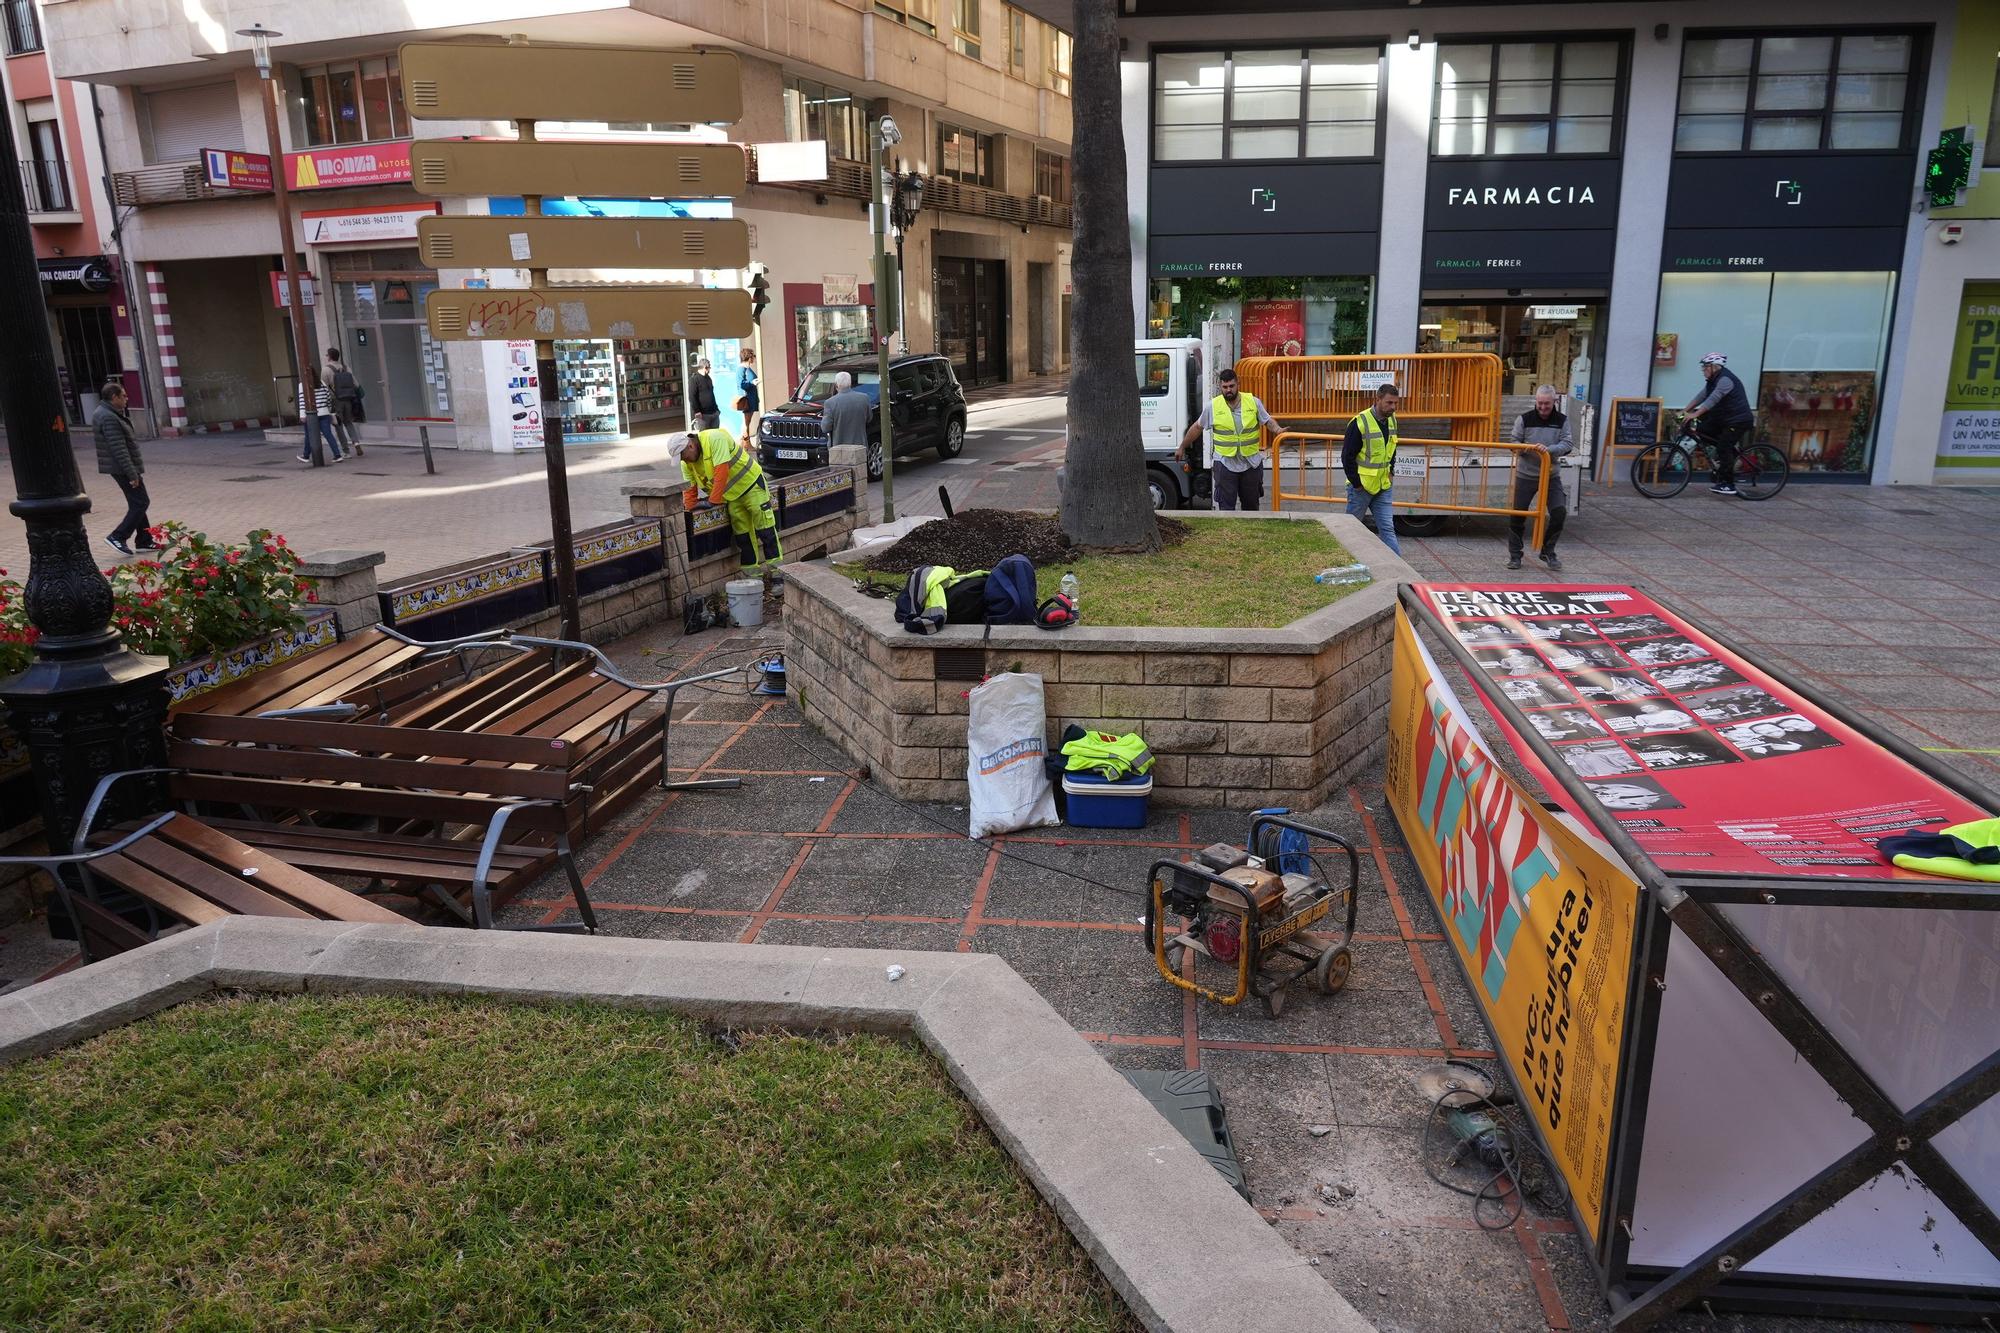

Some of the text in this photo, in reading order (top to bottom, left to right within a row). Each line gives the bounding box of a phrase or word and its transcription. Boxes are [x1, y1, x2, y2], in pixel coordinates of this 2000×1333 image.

[210, 153, 227, 180] L
[1448, 186, 1595, 205] FARMACIA
[1160, 262, 1243, 271] FARMACIA FERRER
[1435, 259, 1522, 268] FARMACIA FERRER
[1675, 257, 1764, 265] FARMACIA FERRER
[1968, 305, 1984, 316] En
[1957, 383, 1989, 397] Vine
[1955, 416, 1973, 427] ACÍ
[1974, 418, 1989, 428] NO
[1953, 430, 1967, 440] UN
[1395, 456, 1425, 465] LMAKIVI
[1432, 591, 1549, 604] TEATRE
[1440, 601, 1609, 618] PRINCIPAL
[981, 739, 1041, 769] BRICOMART
[1522, 993, 1539, 1079] IVC:
[1534, 1051, 1549, 1105] La
[1549, 1048, 1564, 1131] que
